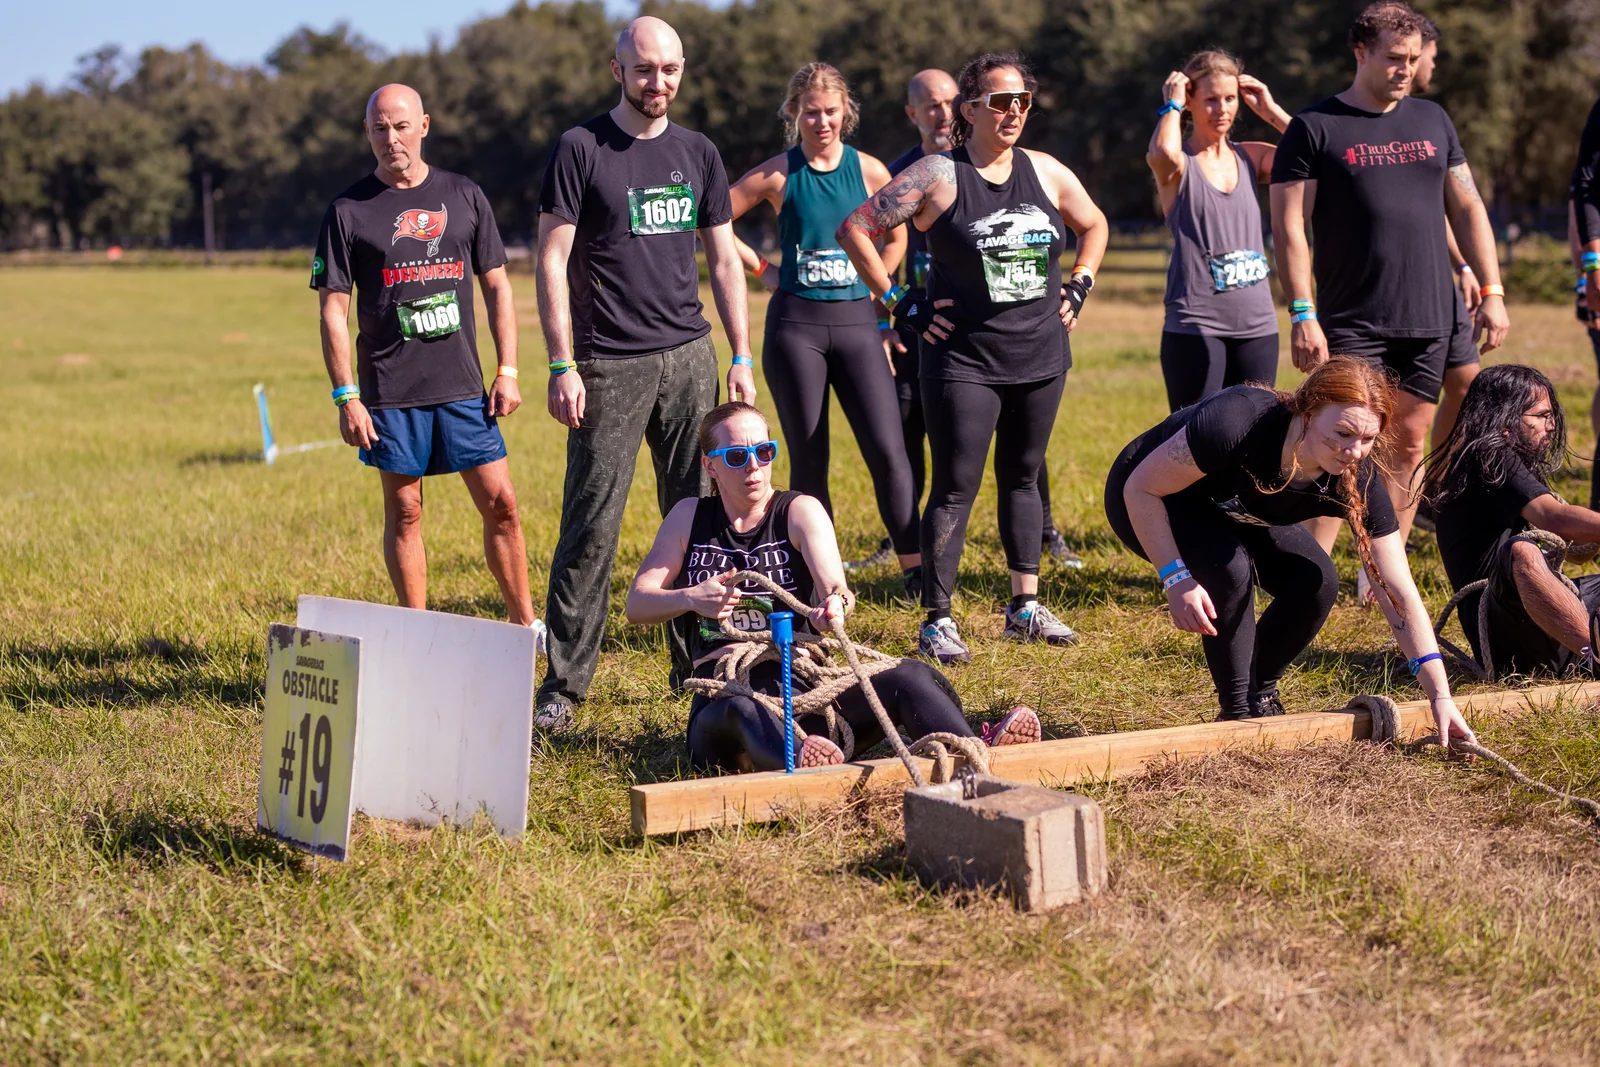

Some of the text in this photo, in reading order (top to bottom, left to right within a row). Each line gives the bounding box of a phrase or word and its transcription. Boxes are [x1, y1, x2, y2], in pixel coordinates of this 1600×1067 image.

[1359, 151, 1427, 167] FITNESS
[641, 197, 693, 226] 1602
[976, 232, 1052, 249] SAVAGERACE
[382, 260, 464, 287] BUCCANEERS
[394, 256, 454, 268] TAMPA BAY
[1223, 258, 1267, 286] 2423
[410, 303, 460, 333] 1060
[688, 549, 790, 569] BUT DID
[282, 669, 339, 705] OBSTACLE
[279, 712, 332, 825] #19
